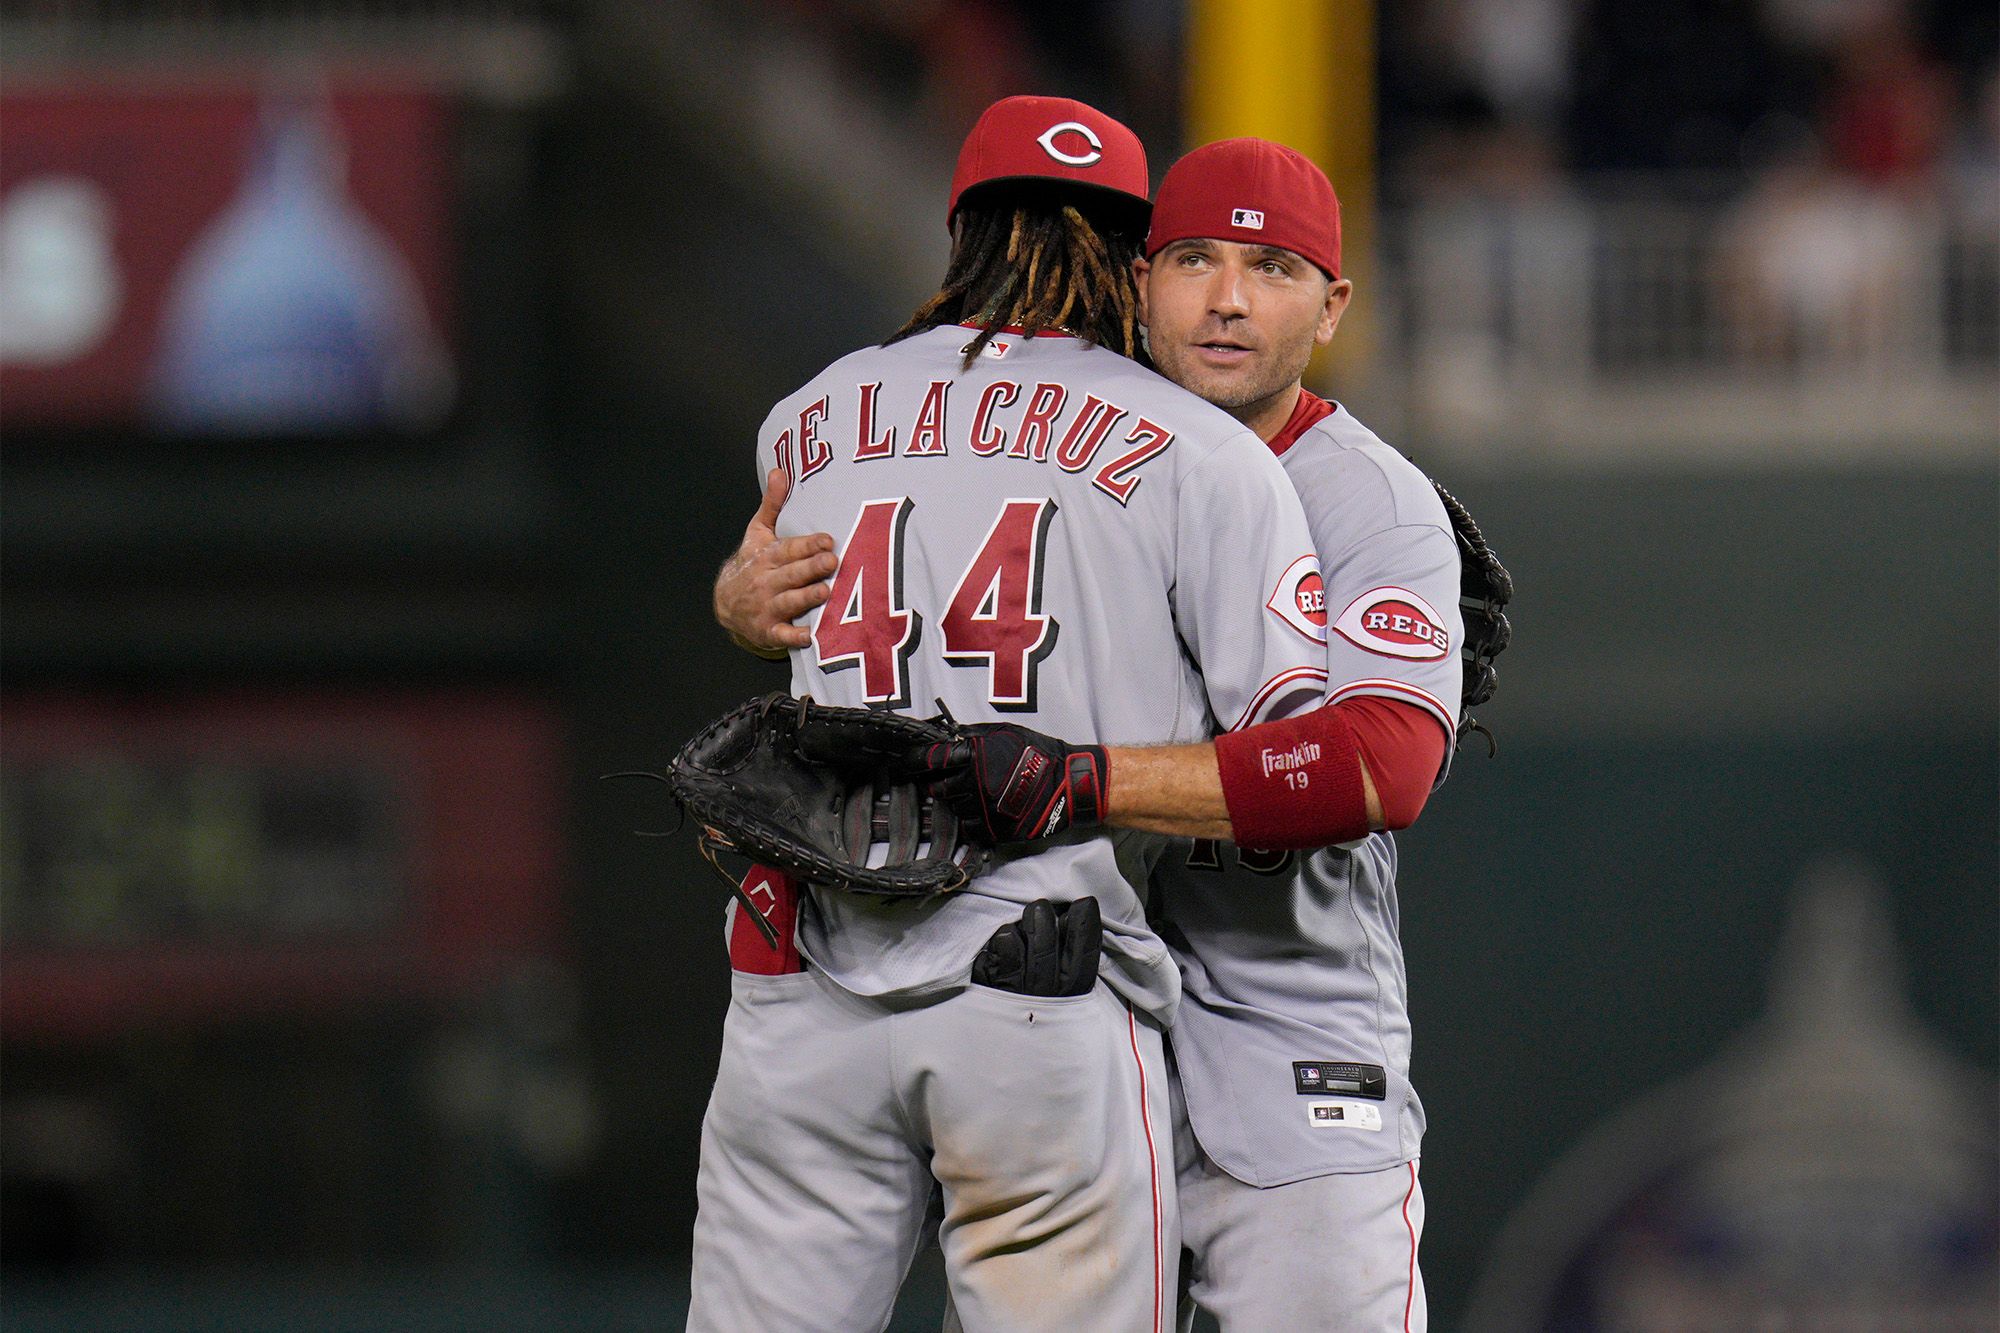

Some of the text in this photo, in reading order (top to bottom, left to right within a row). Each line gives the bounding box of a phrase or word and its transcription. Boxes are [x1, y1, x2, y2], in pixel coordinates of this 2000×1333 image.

[1037, 121, 1103, 167] C
[772, 380, 1175, 511] DE LA CRUZ
[810, 496, 1060, 713] 44
[1297, 590, 1327, 612] RE
[1365, 612, 1448, 651] REDS
[1261, 740, 1321, 778] Franklin
[1284, 771, 1309, 791] 19
